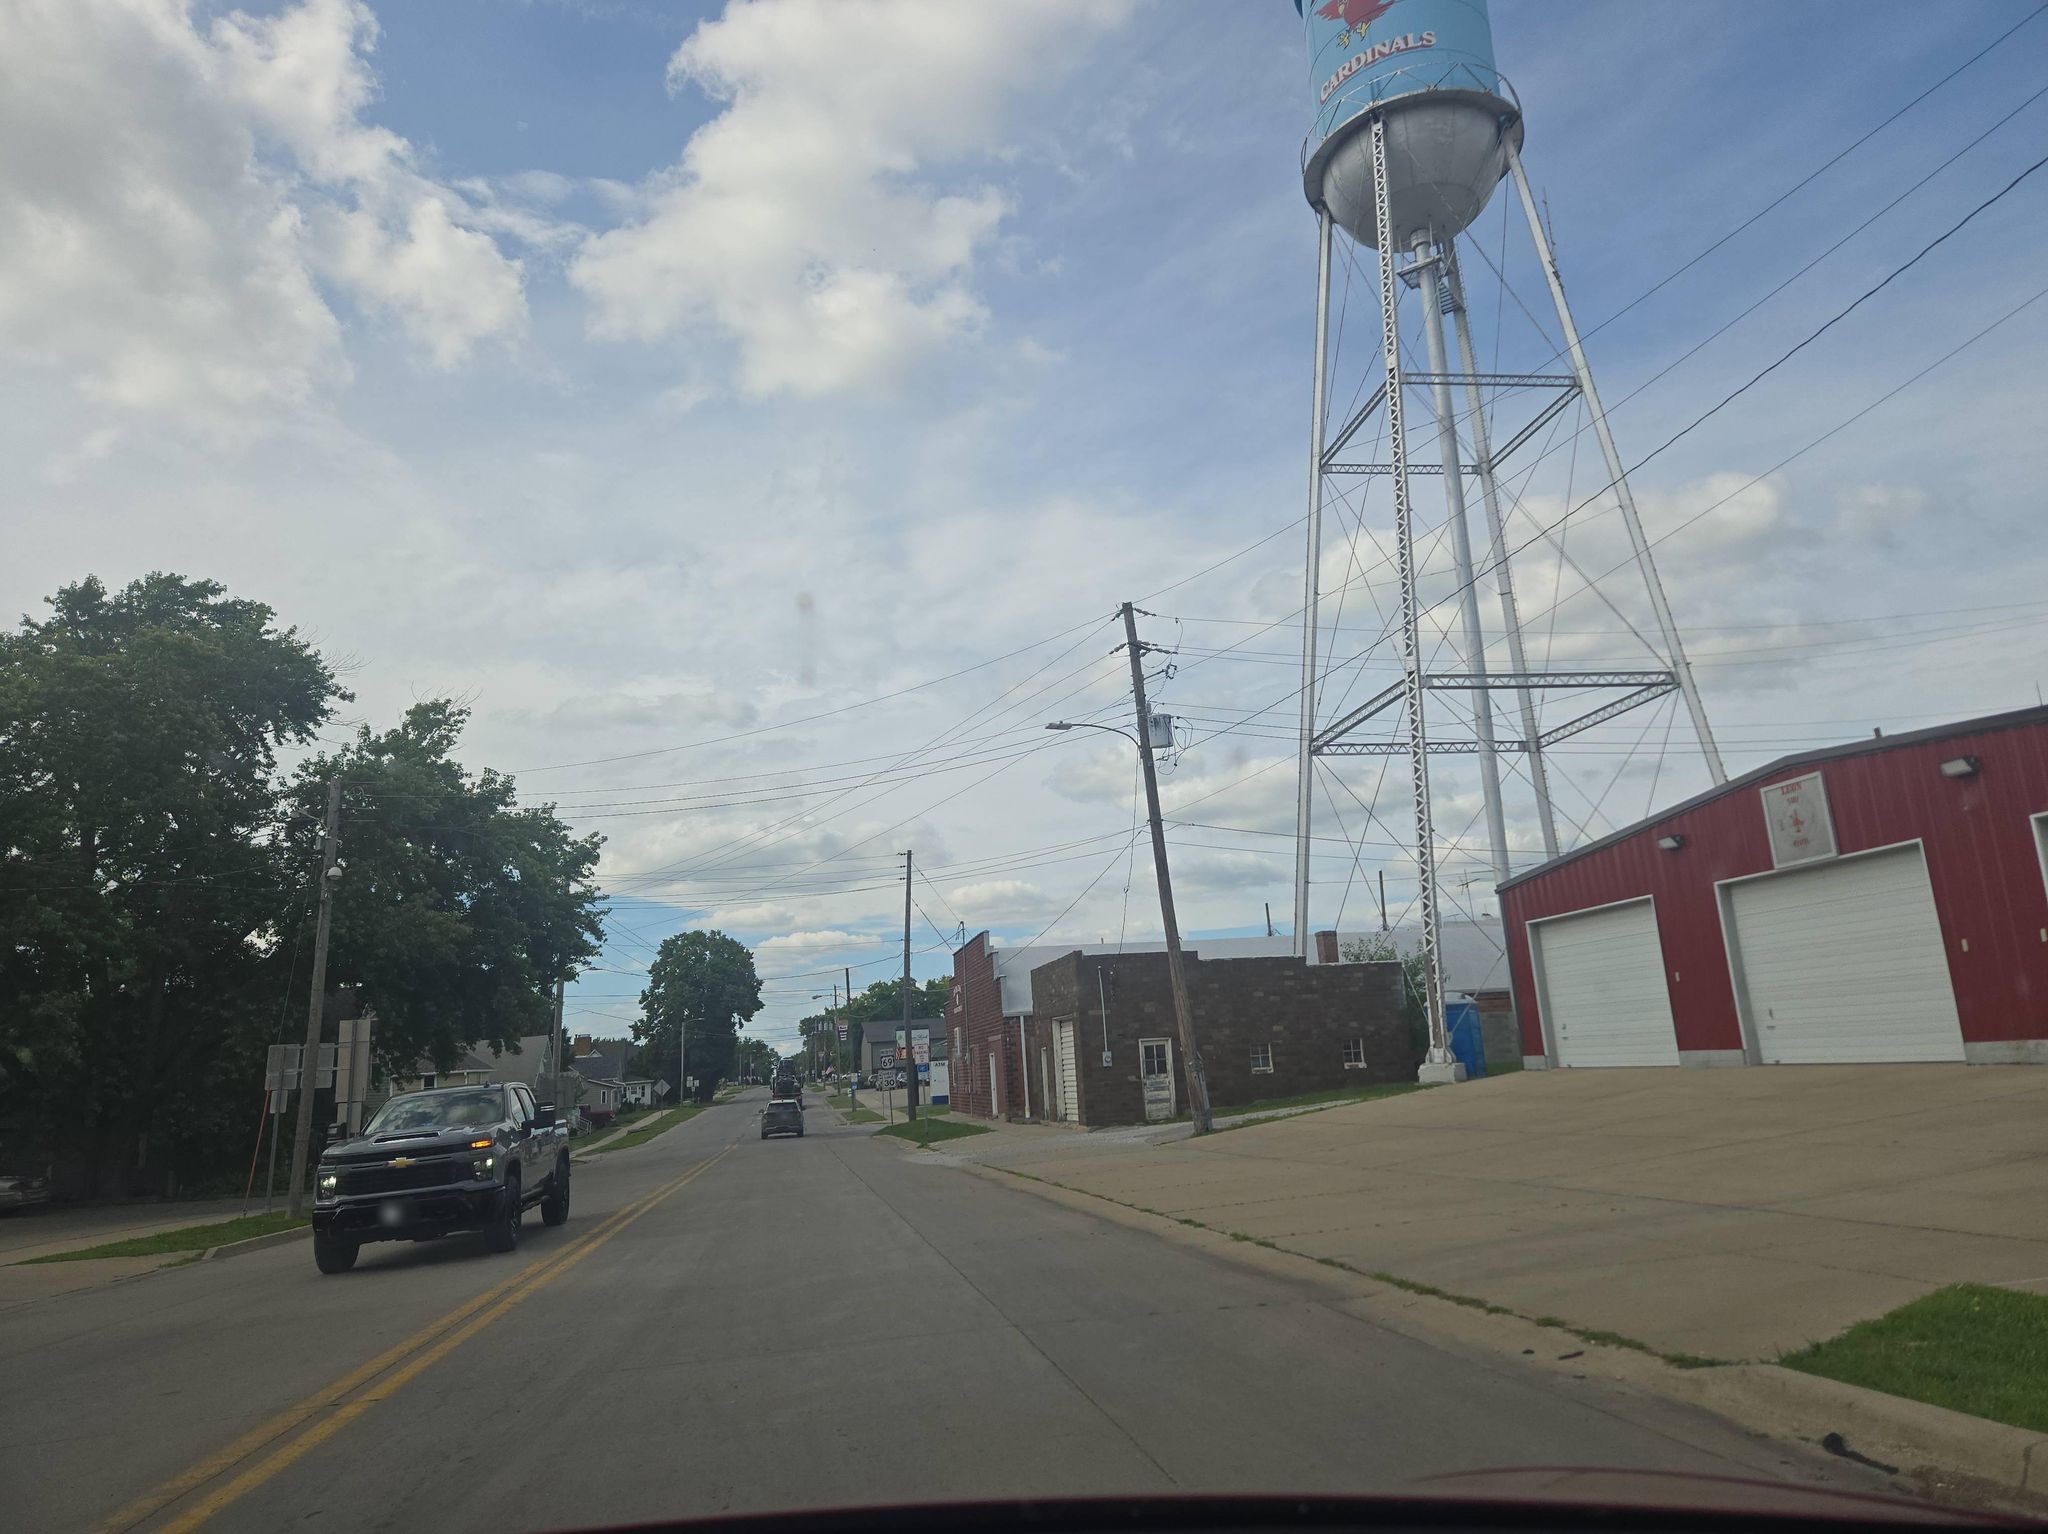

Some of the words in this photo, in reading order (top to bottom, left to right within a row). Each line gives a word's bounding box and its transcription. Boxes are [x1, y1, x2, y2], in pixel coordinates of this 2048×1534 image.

[1320, 31, 1437, 104] CARDINALS
[882, 1058, 892, 1067] 69
[884, 1079, 895, 1087] 30
